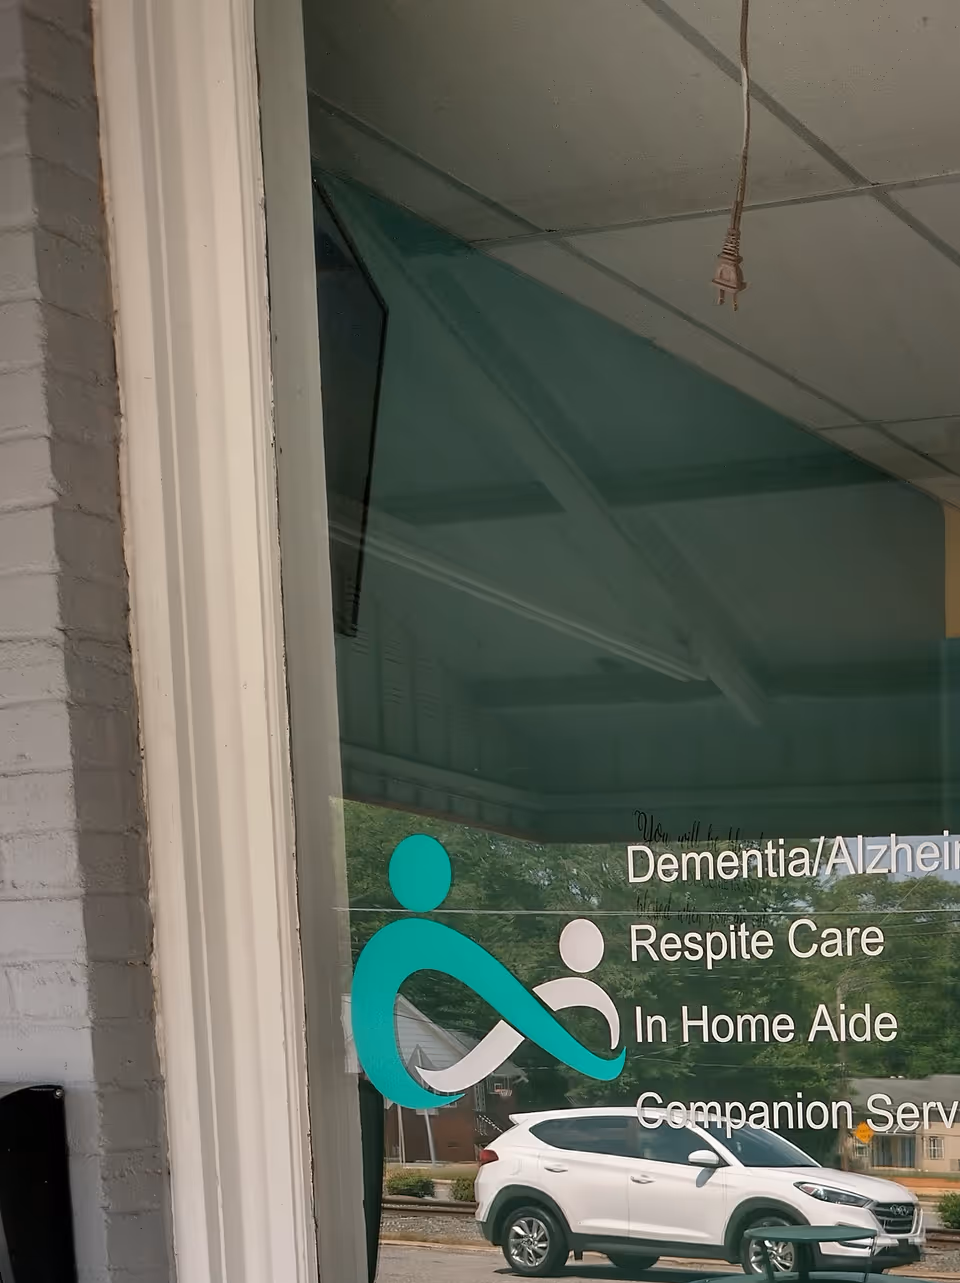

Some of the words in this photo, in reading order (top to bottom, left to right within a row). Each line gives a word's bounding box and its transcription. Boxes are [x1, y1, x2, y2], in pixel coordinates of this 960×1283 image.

[631, 922, 774, 970] Respite
[787, 919, 885, 959] Care
[634, 1006, 667, 1044] In
[681, 1005, 795, 1044] Home
[808, 1003, 899, 1043] Aide
[636, 1091, 853, 1138] Companion
